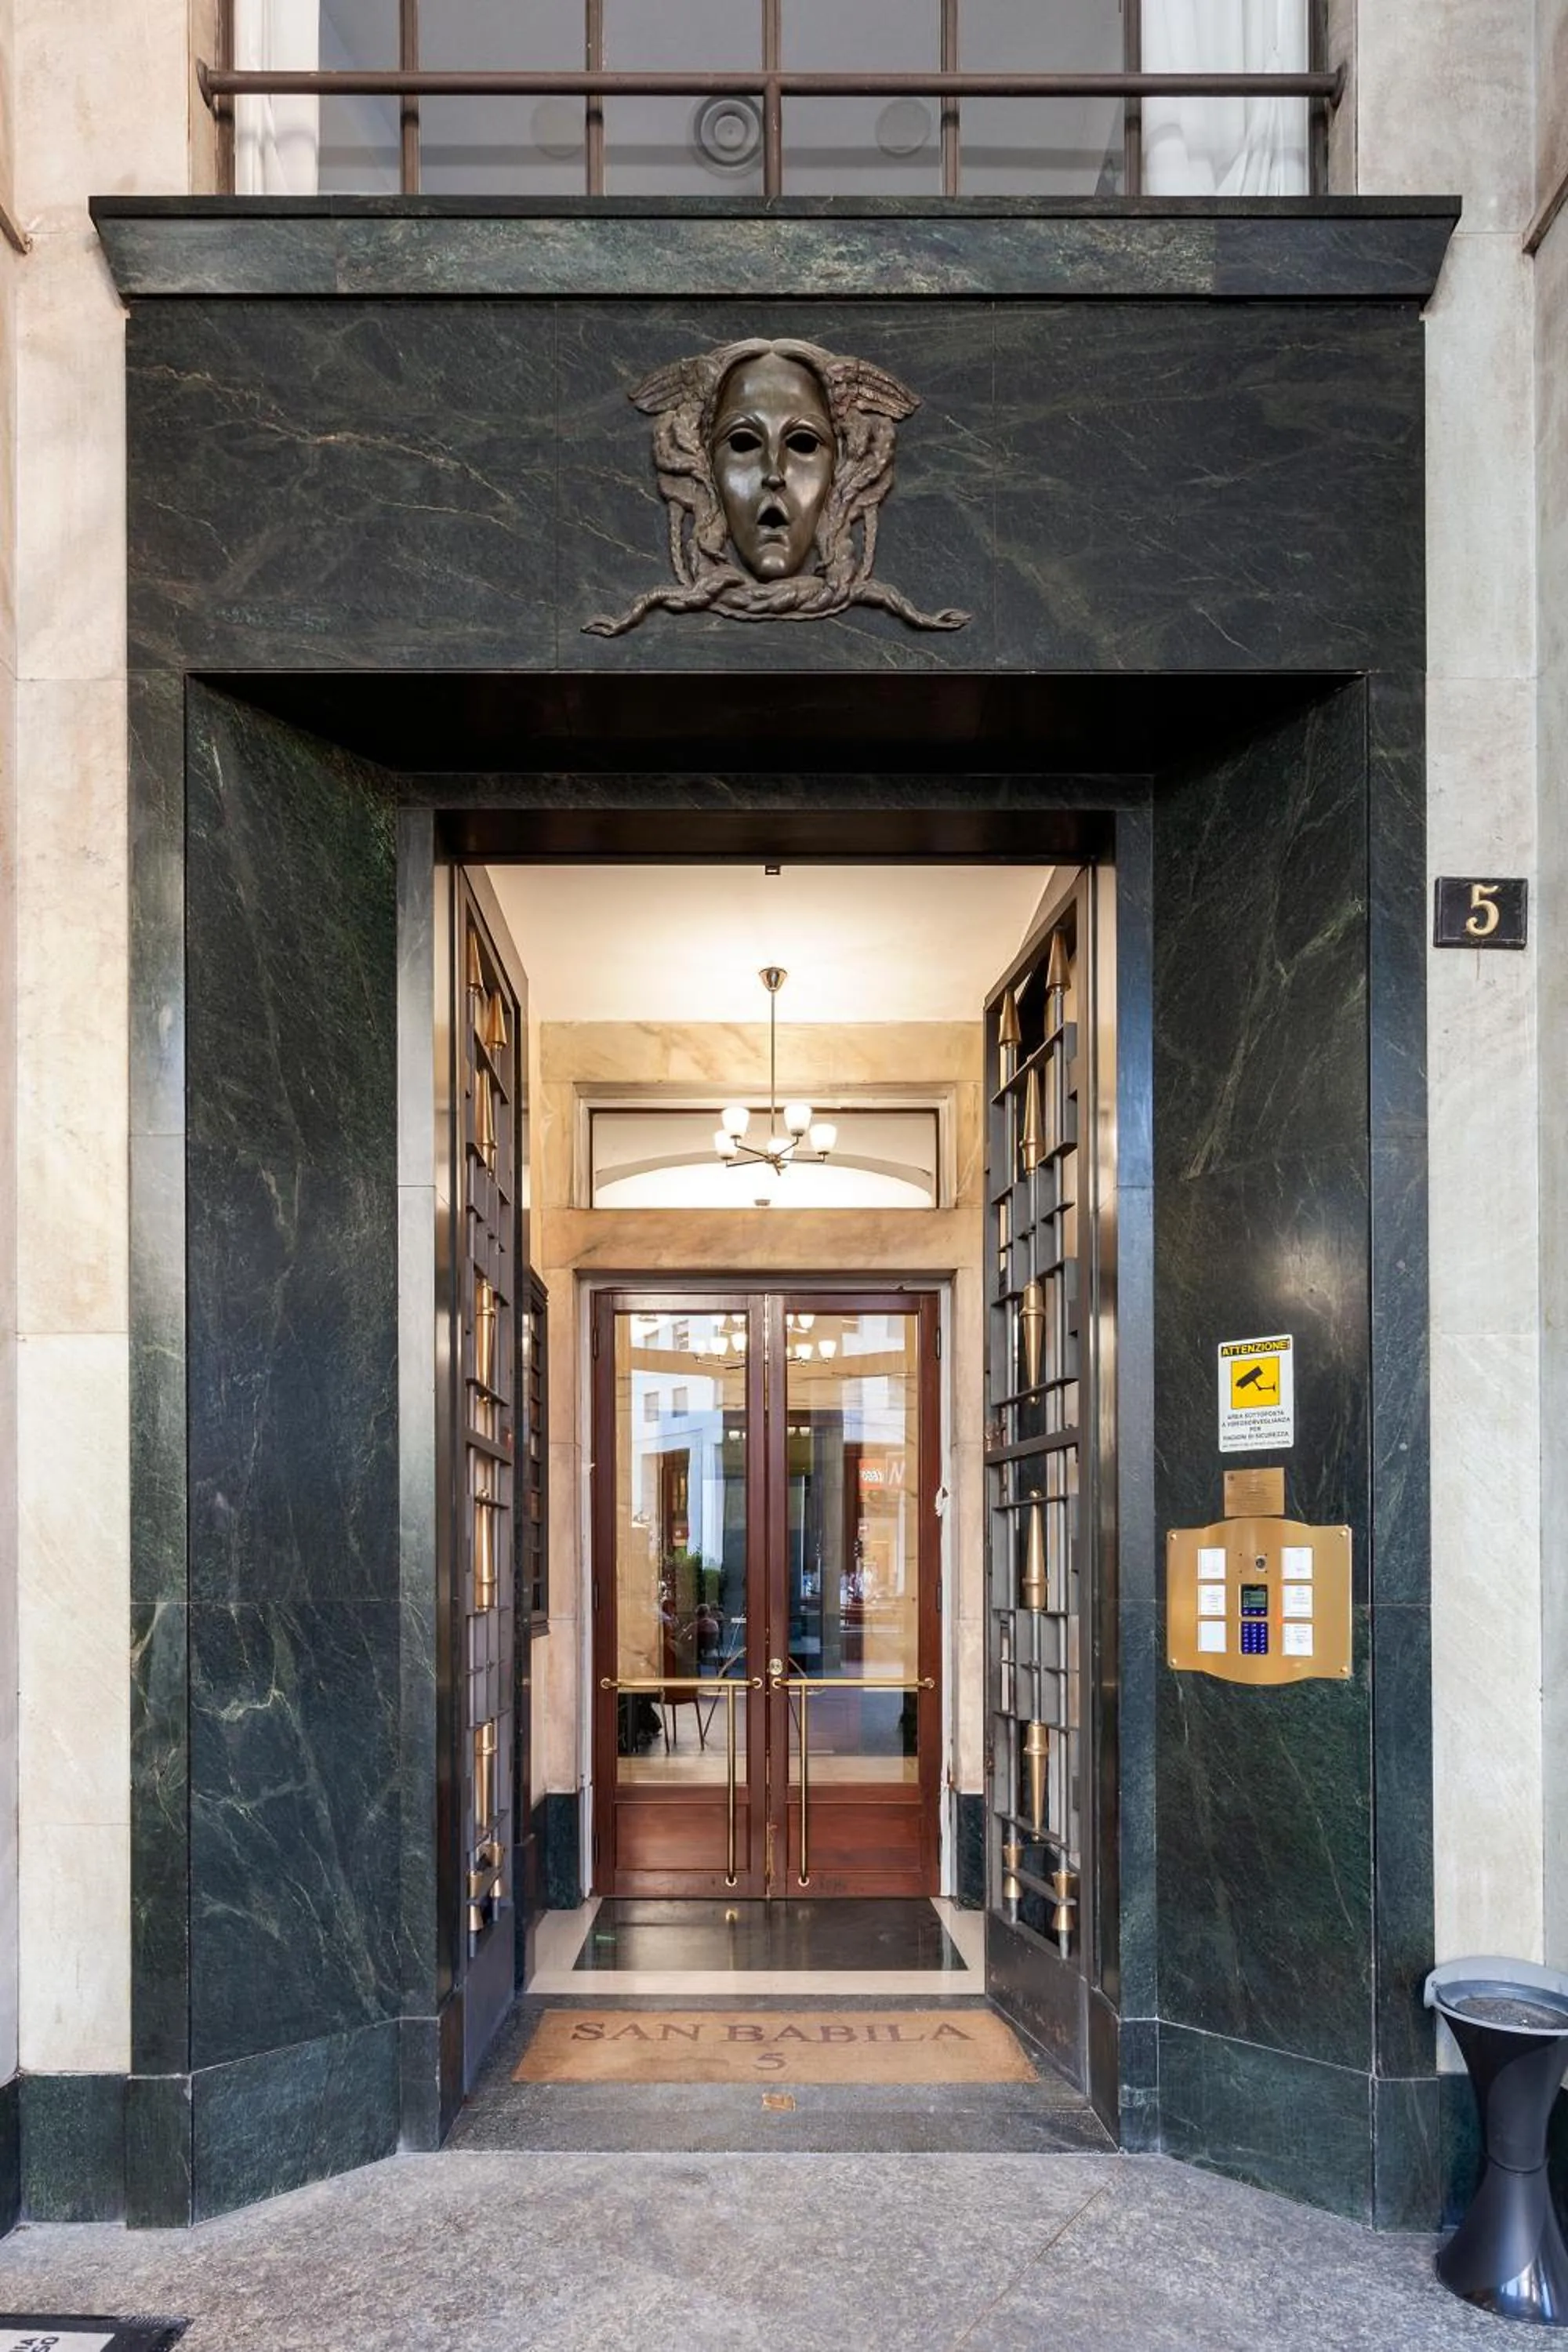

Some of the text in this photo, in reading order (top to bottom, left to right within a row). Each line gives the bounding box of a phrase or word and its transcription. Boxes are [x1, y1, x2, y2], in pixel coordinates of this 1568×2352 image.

[1465, 884, 1499, 936] 5
[572, 2022, 977, 2042] SAN BABILA
[753, 2052, 786, 2071] 5
